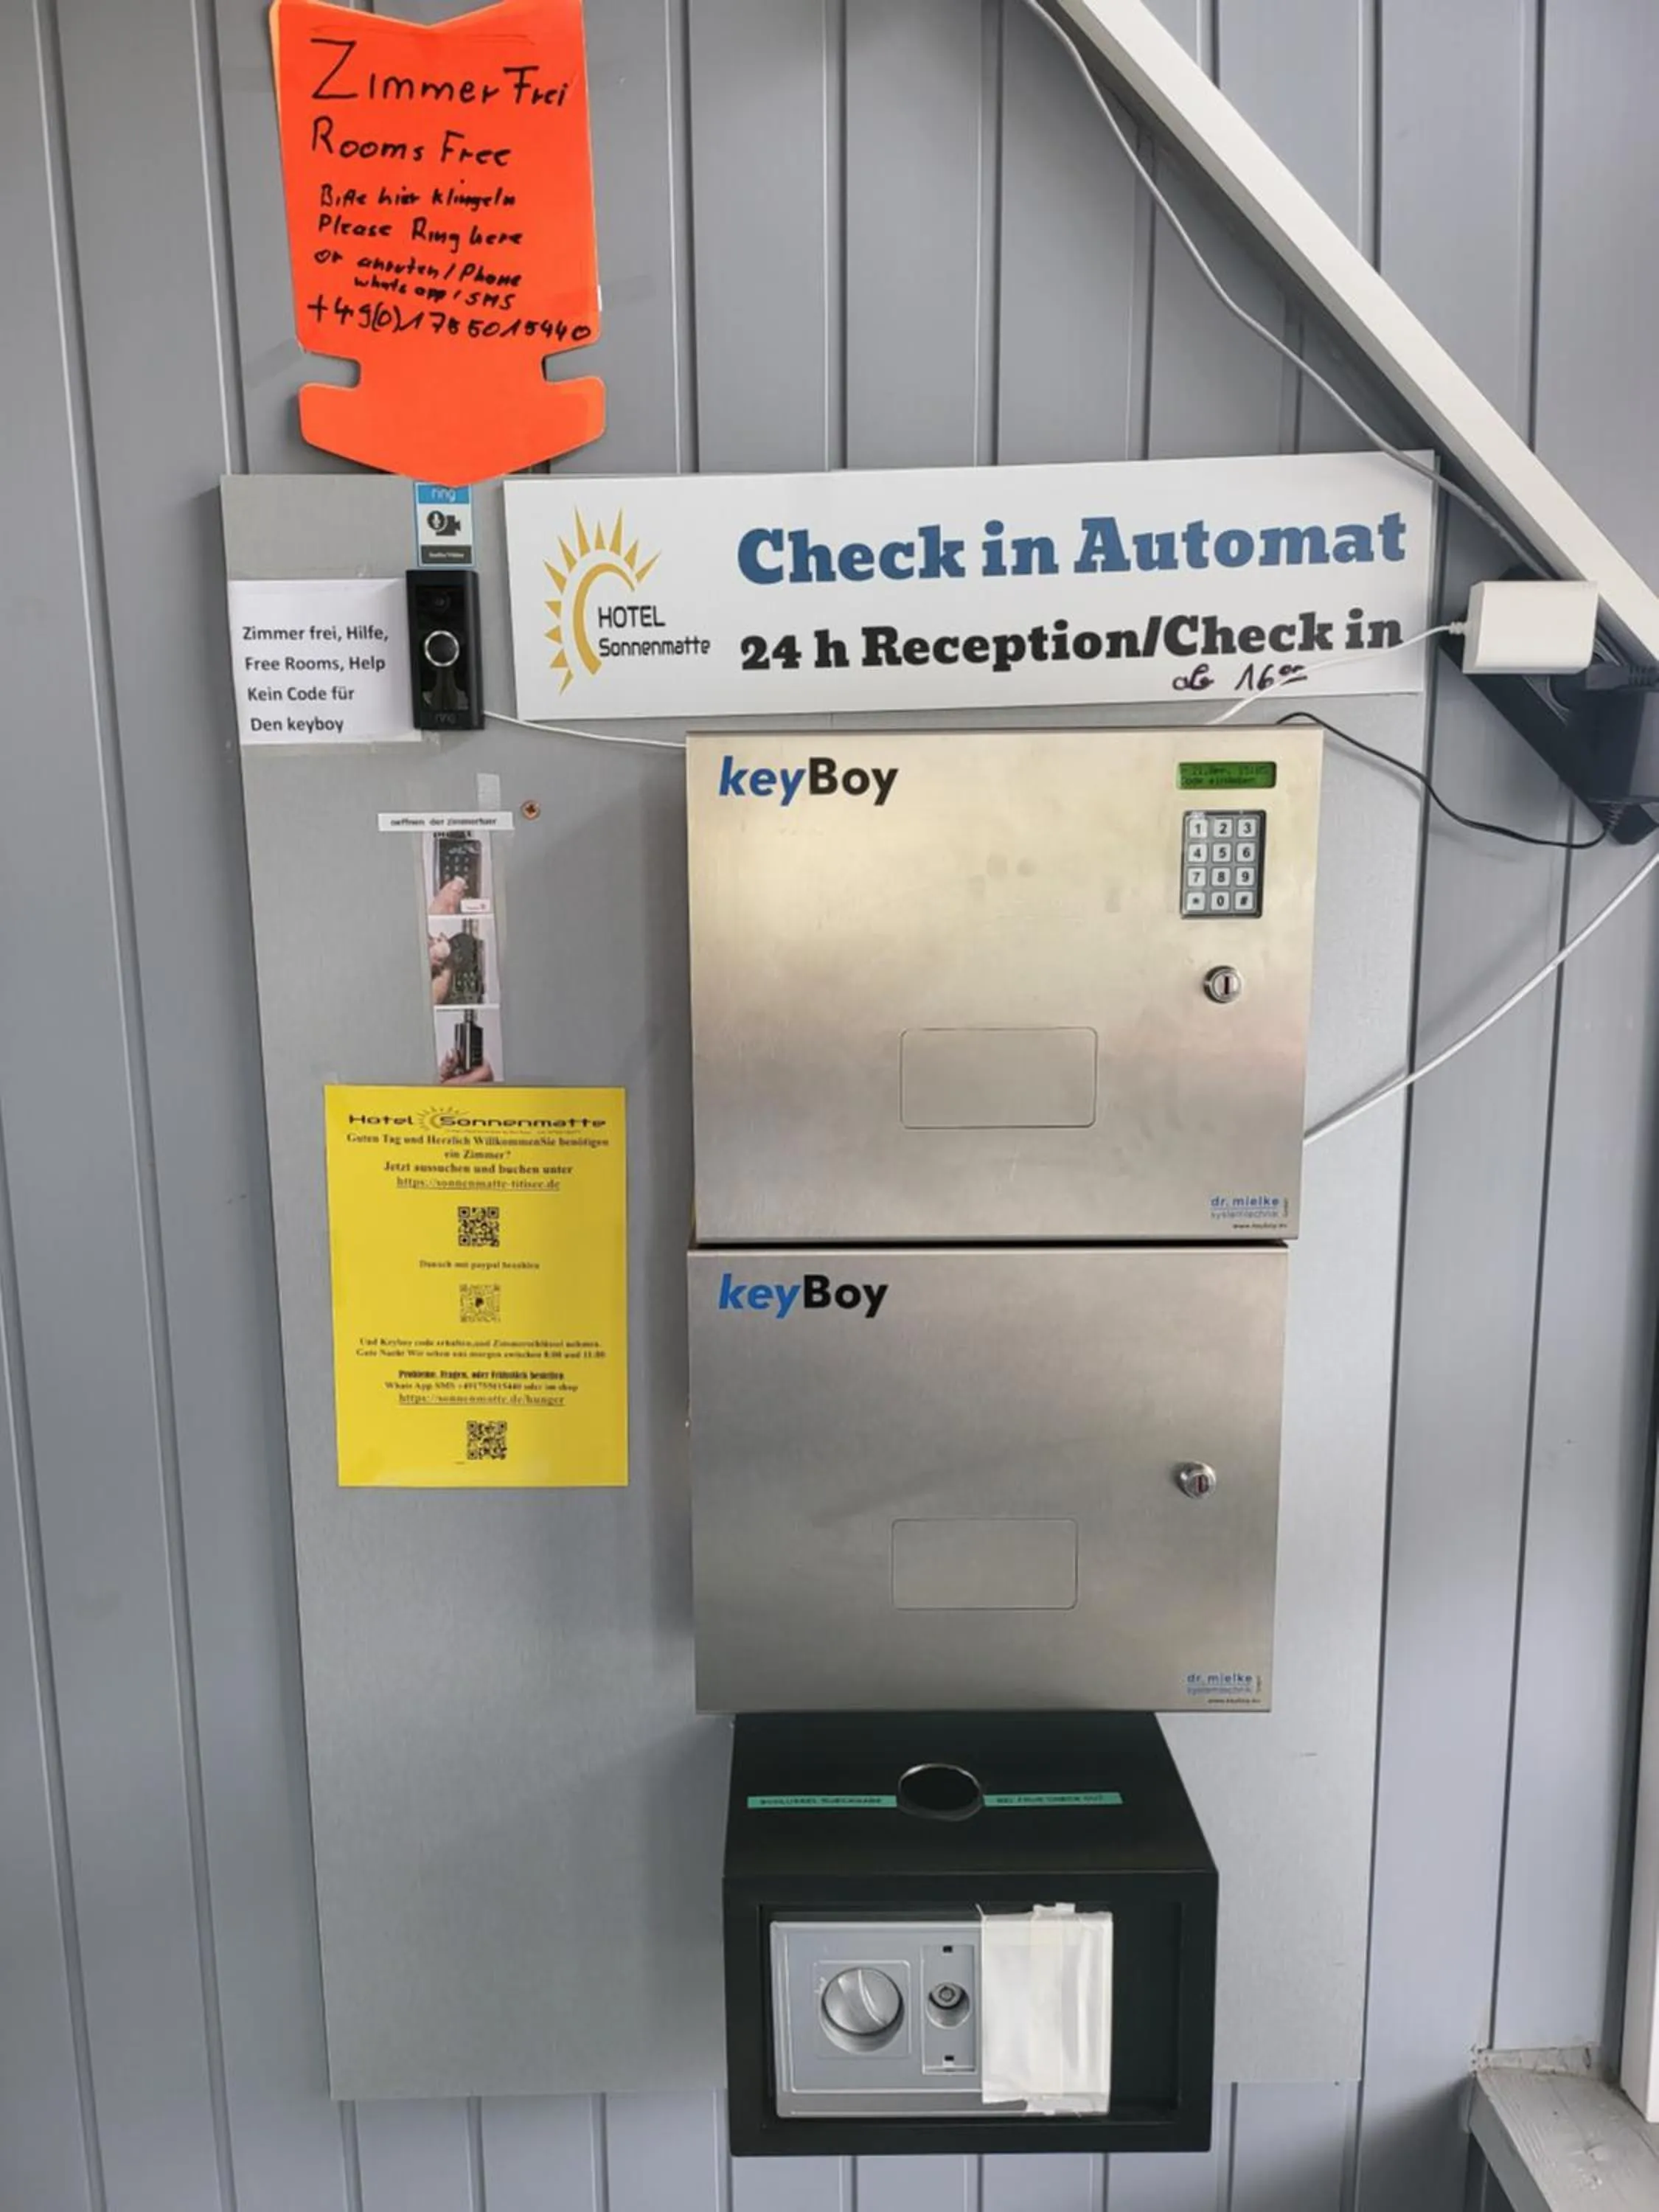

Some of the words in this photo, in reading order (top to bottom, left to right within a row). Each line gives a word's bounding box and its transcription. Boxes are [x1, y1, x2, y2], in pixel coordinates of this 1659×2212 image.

[310, 38, 499, 103] Zimmer
[503, 66, 568, 106] Frei
[311, 116, 424, 161] Rooms
[440, 131, 512, 167] Free
[320, 183, 367, 207] Bitte
[378, 186, 420, 205] hier
[318, 213, 392, 237] Please
[411, 216, 460, 254] Ring
[469, 225, 523, 245] here
[737, 524, 966, 585] Check
[982, 520, 1059, 577] in
[1074, 512, 1406, 574] Automat
[598, 605, 667, 628] HOTEL
[242, 626, 306, 640] Zimmer
[309, 625, 342, 642] frei,
[347, 625, 389, 642] Hilfe,
[740, 635, 801, 670] 24
[814, 629, 849, 668] h
[861, 611, 1334, 673] Reception/Check
[1345, 608, 1405, 650] in
[599, 635, 711, 657] Sonnenmatte
[245, 657, 280, 671] Free
[285, 656, 344, 672] Rooms,
[349, 655, 386, 672] Help
[247, 686, 282, 701] Kein
[287, 685, 327, 701] Code
[331, 684, 355, 700] für
[251, 717, 282, 731] Den
[287, 715, 344, 734] keyboy
[718, 755, 900, 807] keyBoy
[1194, 823, 1201, 834] 1
[1219, 822, 1228, 834] 2
[1243, 822, 1252, 833] 3
[1193, 848, 1201, 858] 4
[1218, 848, 1226, 858] 5
[1242, 847, 1251, 858] 6
[1193, 872, 1200, 883] 7
[1217, 872, 1225, 883] 8
[1241, 872, 1249, 883] 9
[1217, 895, 1225, 907] 0
[349, 1114, 413, 1126] Hotel
[440, 1116, 606, 1127] Sonnenmatte
[347, 1133, 380, 1144] Guten
[383, 1134, 402, 1145] Tag
[404, 1134, 424, 1144] und
[444, 1150, 461, 1159] ein
[383, 1161, 411, 1172] Jetzt
[414, 1163, 471, 1174] aussuchen
[474, 1164, 495, 1174] und
[498, 1164, 540, 1175] buchen
[542, 1165, 574, 1175] unter
[1232, 1195, 1280, 1206] mielke
[718, 1273, 889, 1319] keyBoy
